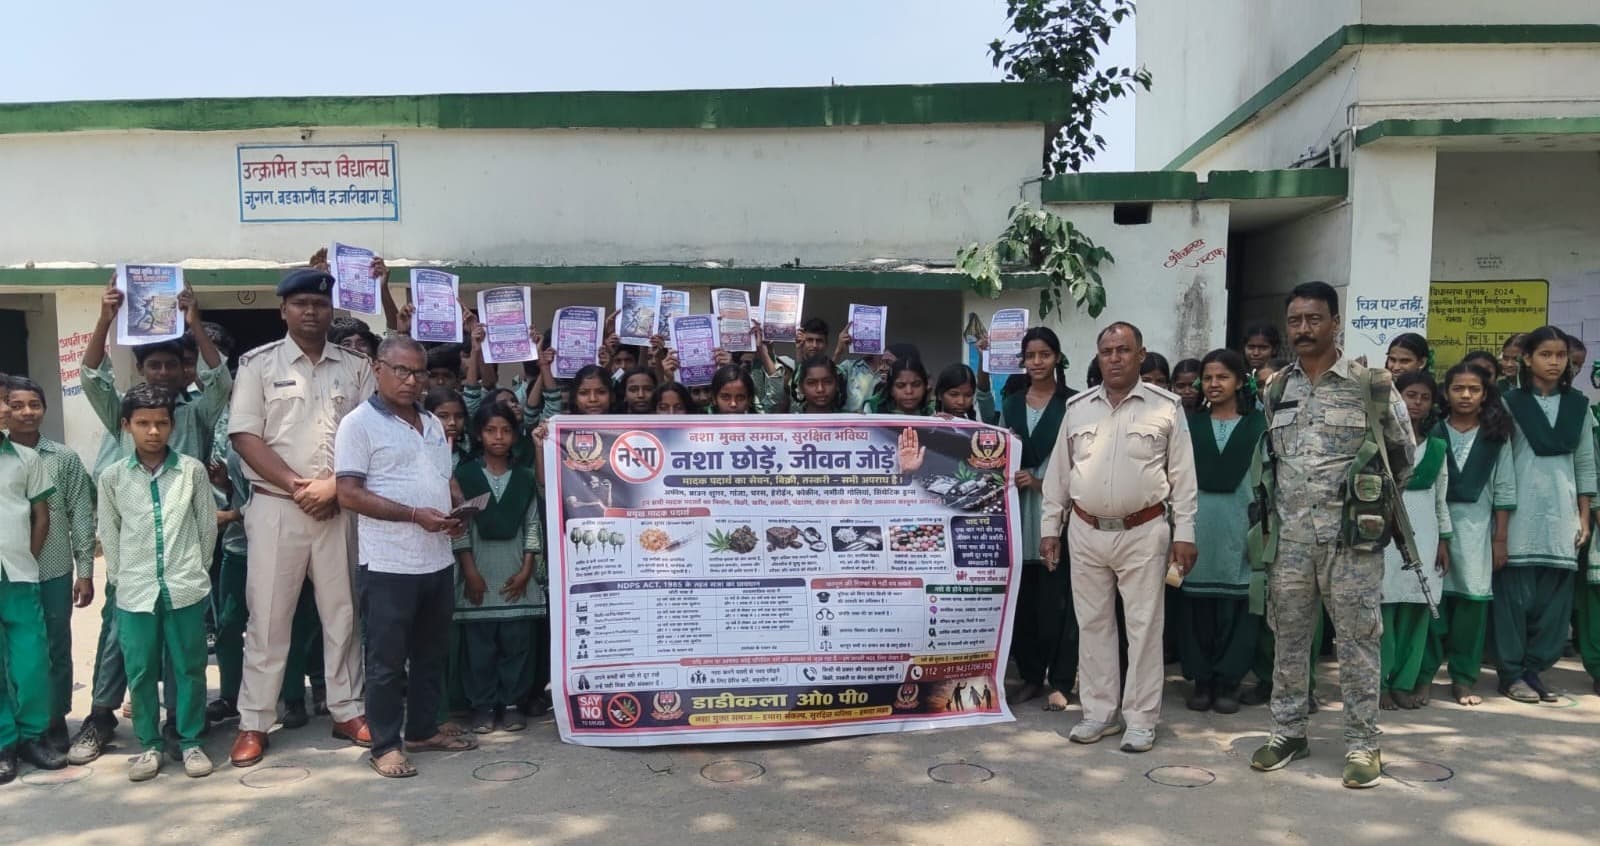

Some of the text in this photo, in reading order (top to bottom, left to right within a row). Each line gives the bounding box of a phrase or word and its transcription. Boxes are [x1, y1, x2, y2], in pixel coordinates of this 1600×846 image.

[243, 154, 389, 181] उत्क्रमित उच्च विद्यालय
[1494, 288, 1514, 296] 2024
[1357, 296, 1377, 311] चित्र
[1382, 299, 1398, 311] पर
[1352, 315, 1378, 330] चरित्र
[1381, 318, 1396, 329] पर
[689, 430, 868, 445] नशा मुक्त समाज, सुरक्षित भविष्य
[617, 447, 657, 467] नशा
[671, 443, 895, 473] नशा छोड़ें, जीवन जोड़ें
[925, 667, 937, 675] 112
[579, 697, 599, 706] SAY
[691, 692, 788, 709] डाडीकला
[580, 706, 601, 719] NO
